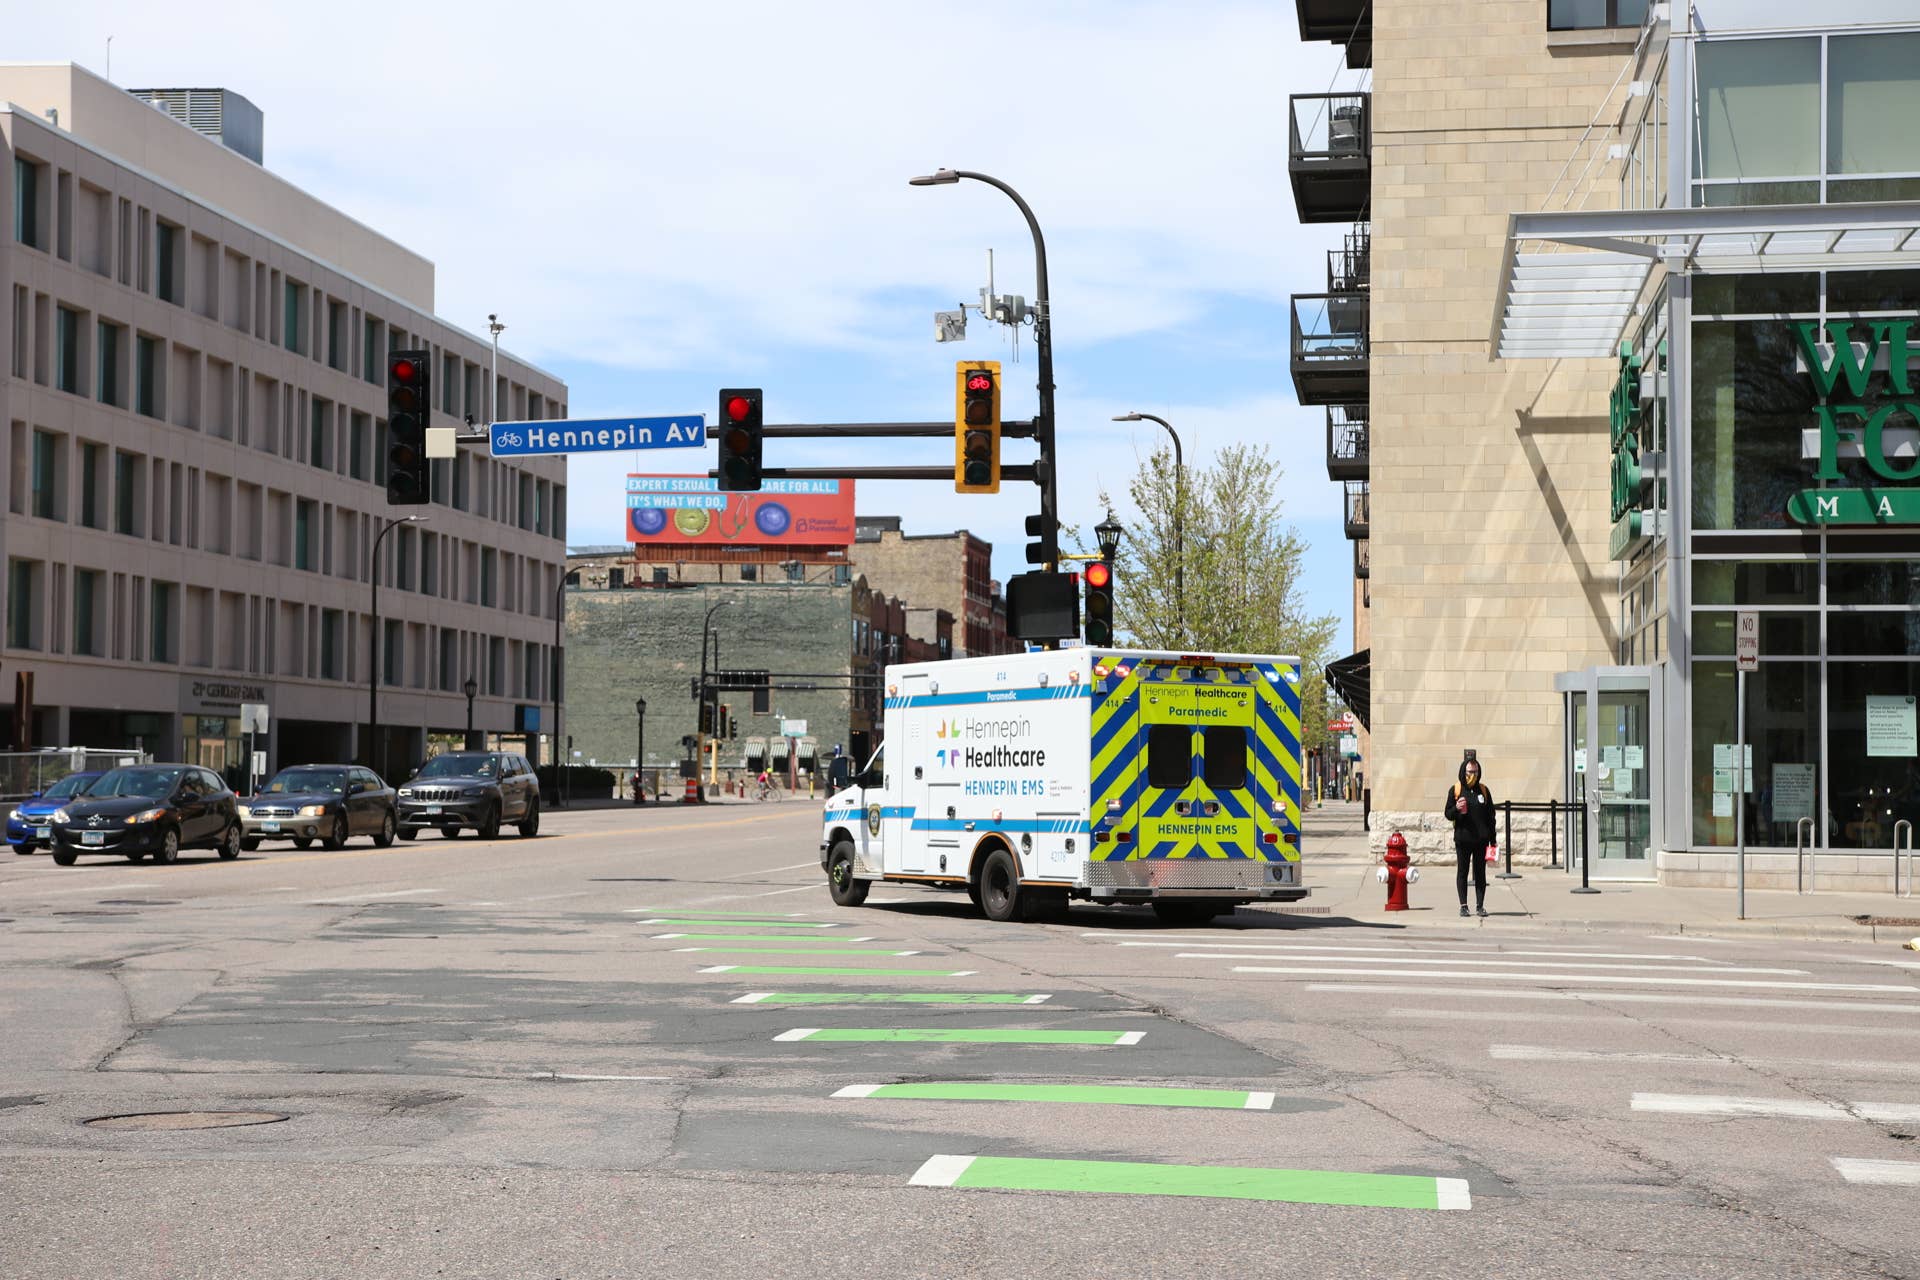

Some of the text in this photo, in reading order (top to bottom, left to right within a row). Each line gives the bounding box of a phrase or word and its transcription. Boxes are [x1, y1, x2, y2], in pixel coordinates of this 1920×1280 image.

[528, 422, 699, 448] Hennepin Av
[629, 479, 669, 491] EXPERT
[671, 479, 710, 491] SEXUAL
[788, 481, 809, 492] FOR
[812, 481, 835, 492] ALL.
[629, 495, 724, 508] IT'S WHAT WE DO.
[1742, 617, 1754, 632] NO
[1739, 636, 1757, 649] STOPPING
[996, 671, 1007, 681] 414
[986, 690, 1017, 701] Paramedic
[1144, 686, 1248, 700] Hennepin Healthcare
[1105, 699, 1119, 708] 414
[1273, 704, 1287, 714] 414
[1168, 706, 1228, 718] Paramedic
[965, 714, 1031, 744] Hennepin
[965, 745, 1046, 768] Healthcare
[965, 779, 1045, 796] HENNEPIN EMS
[1158, 824, 1238, 835] HENNEPIN EMS
